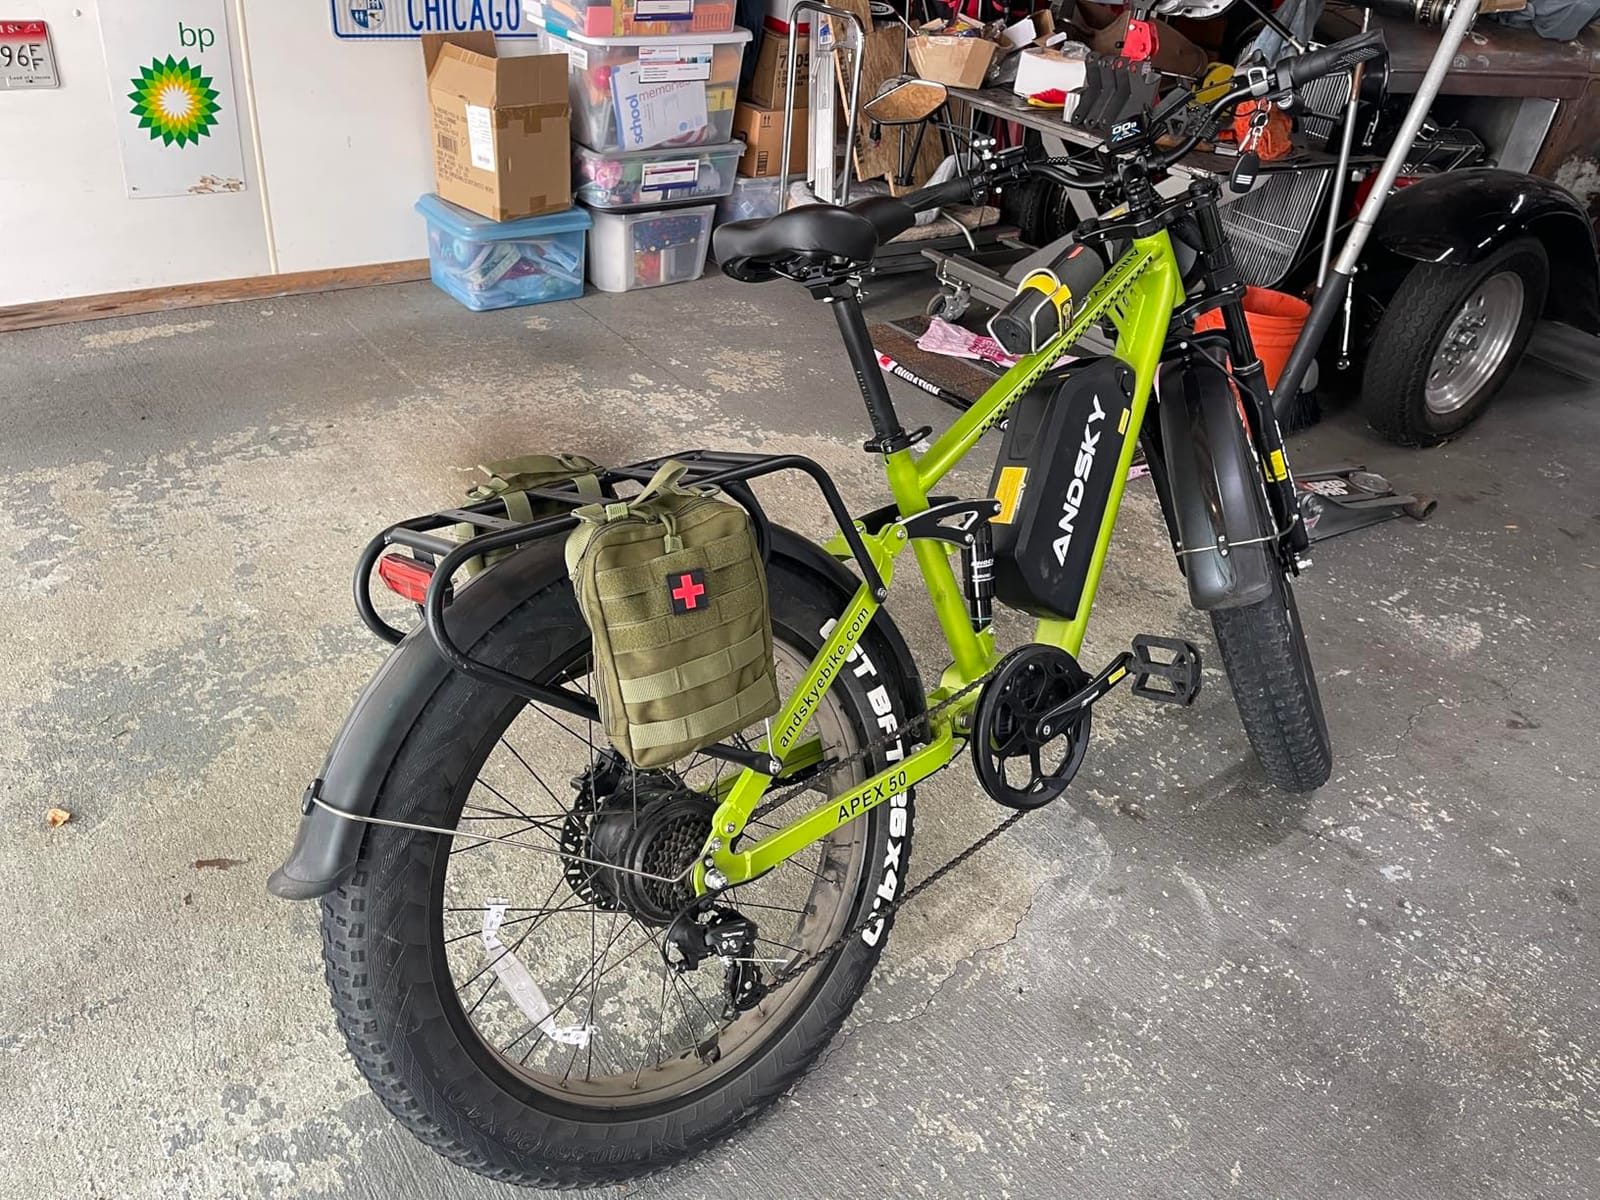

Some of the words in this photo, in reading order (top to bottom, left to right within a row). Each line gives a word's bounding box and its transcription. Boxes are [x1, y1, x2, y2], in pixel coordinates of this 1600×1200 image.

[178, 21, 215, 53] bp
[407, 0, 520, 31] CHICAGO
[624, 93, 645, 145] school
[1093, 249, 1139, 297] ANDSKY
[1052, 393, 1106, 567] ANDSKY
[780, 608, 869, 748] andskyebike.com
[866, 684, 904, 762] BFT
[838, 782, 885, 823] APEX
[889, 770, 906, 792] 50
